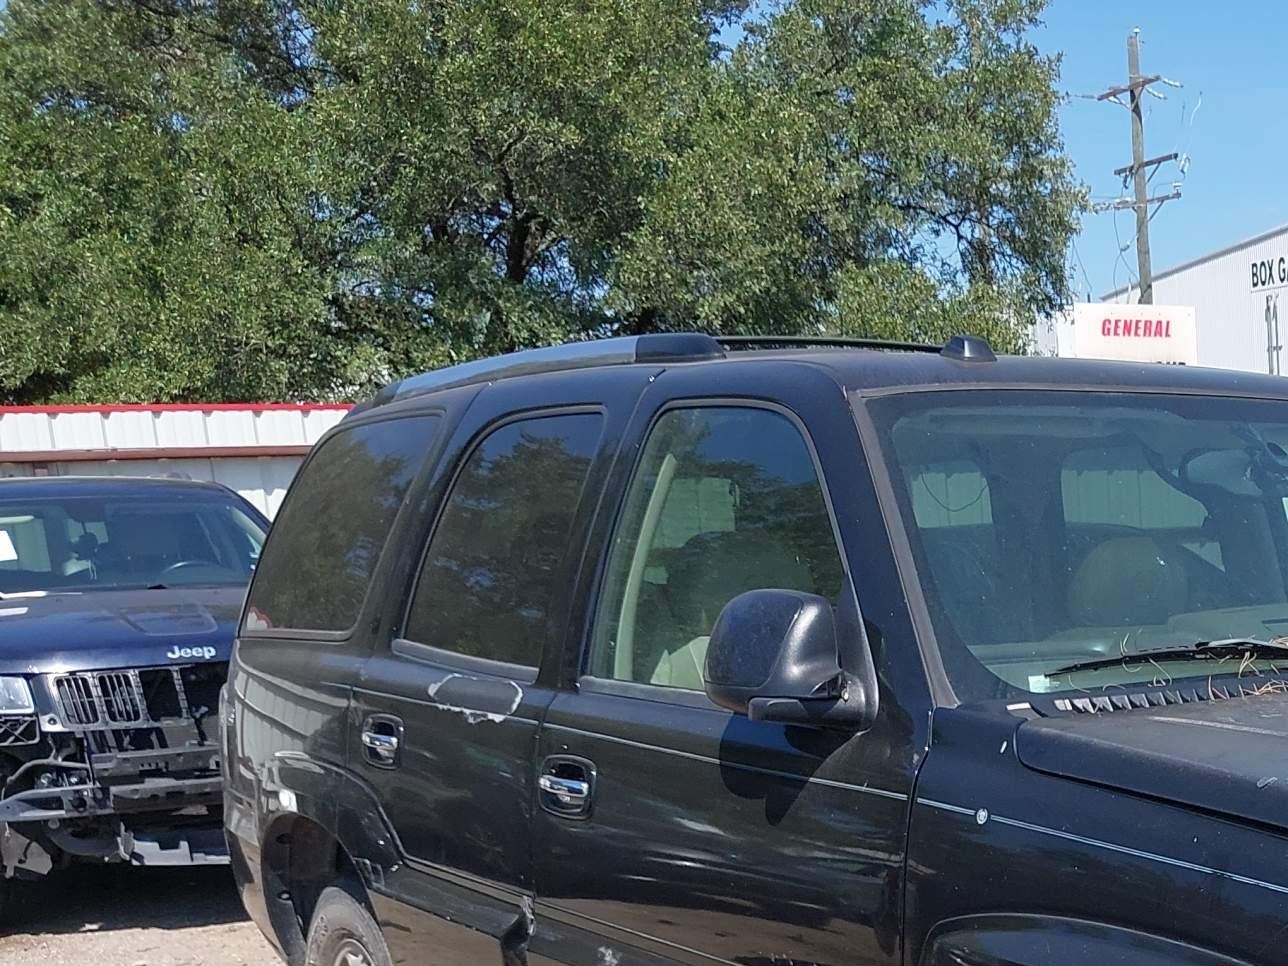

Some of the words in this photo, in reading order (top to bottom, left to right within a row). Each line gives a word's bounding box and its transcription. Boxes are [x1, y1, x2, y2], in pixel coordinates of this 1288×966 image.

[1251, 259, 1275, 288] BOX
[1102, 319, 1171, 337] GENERAL
[167, 645, 217, 660] Jeep
